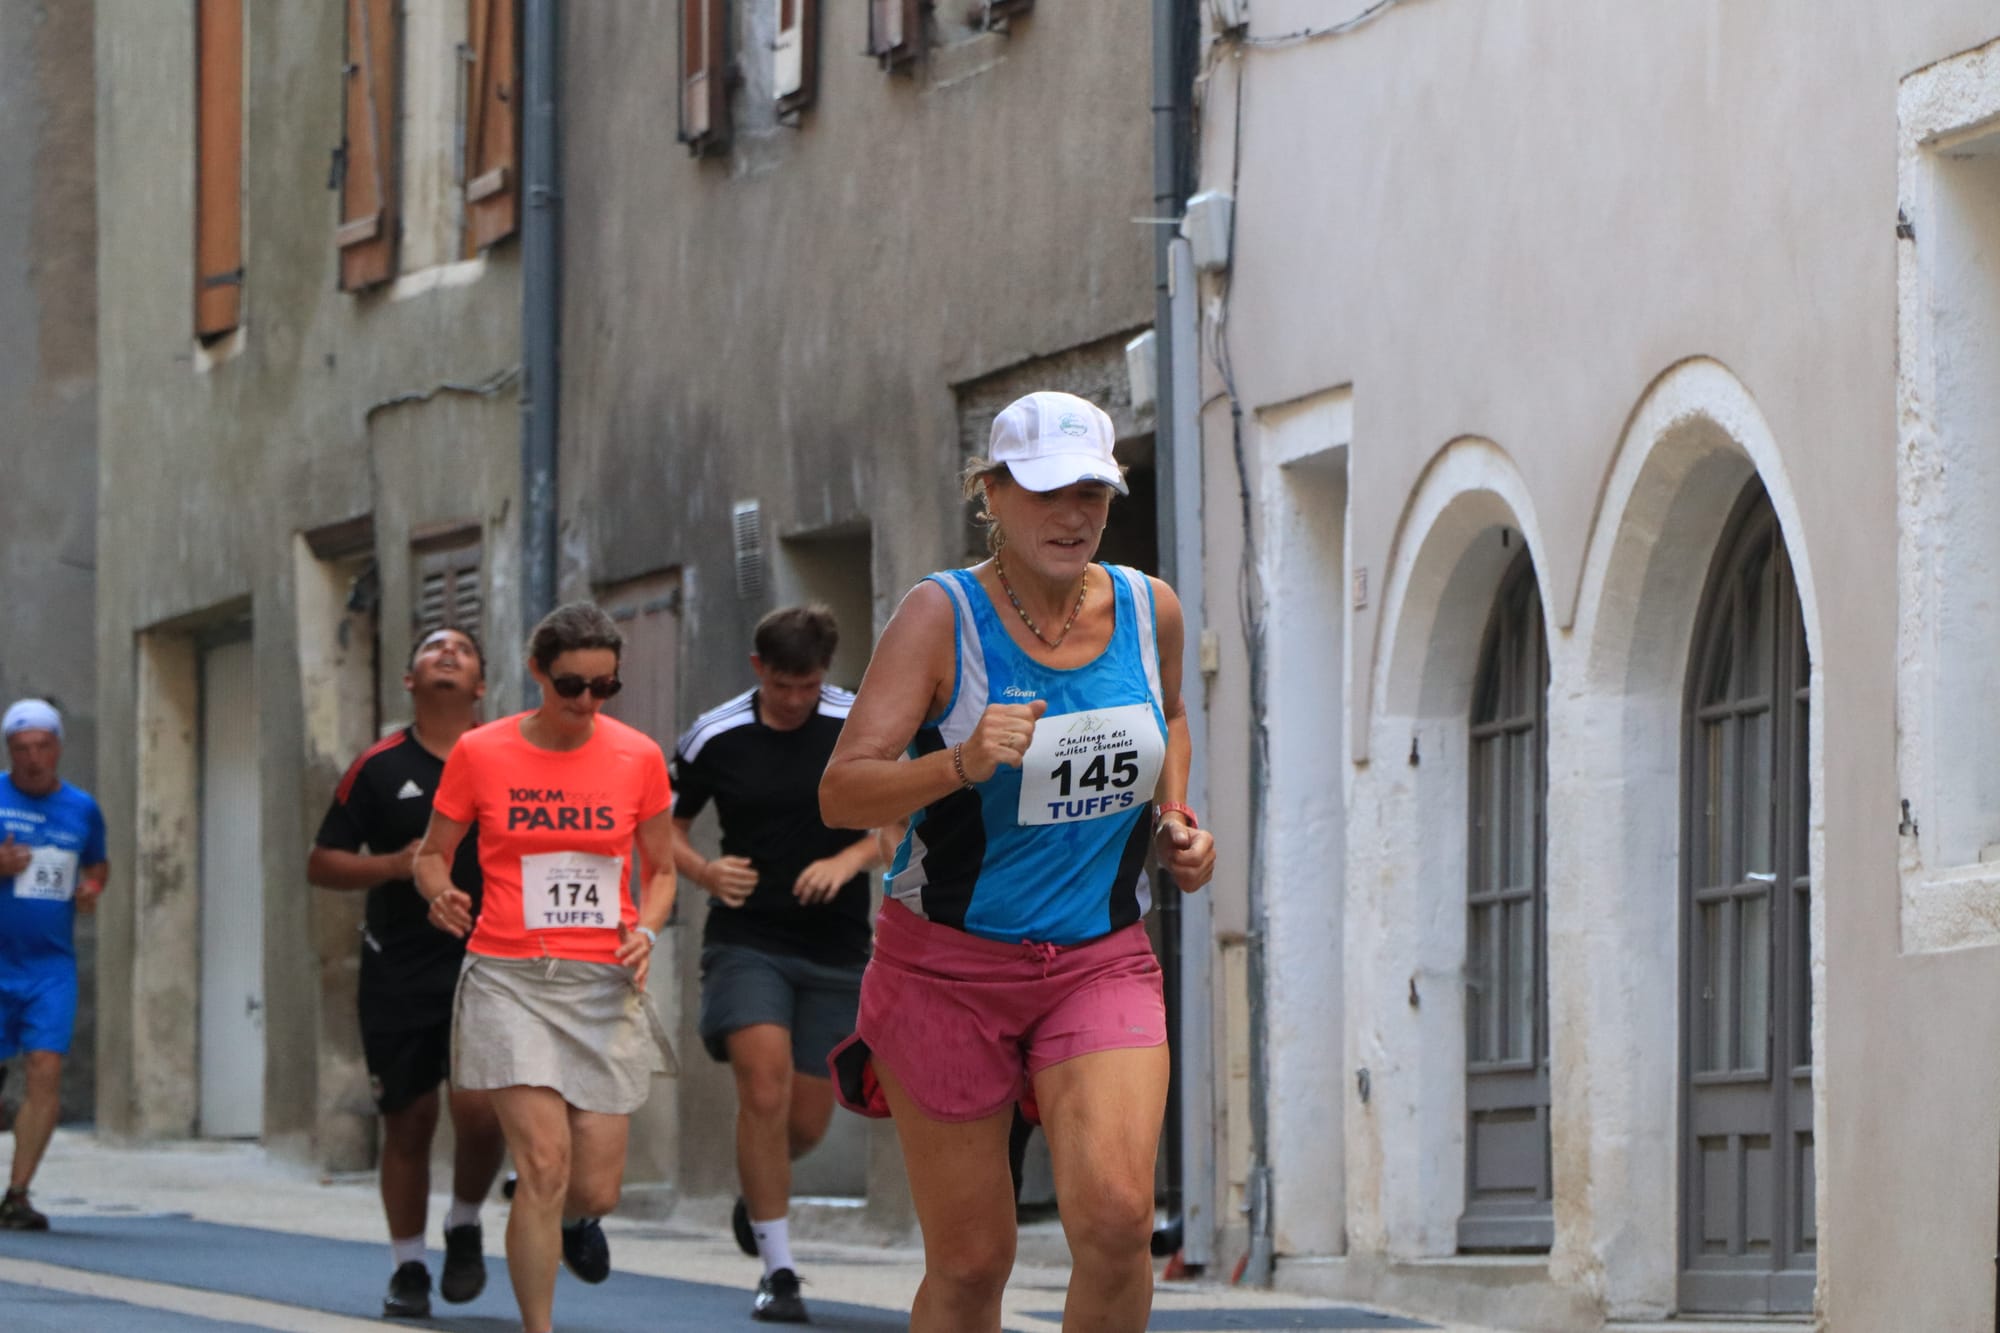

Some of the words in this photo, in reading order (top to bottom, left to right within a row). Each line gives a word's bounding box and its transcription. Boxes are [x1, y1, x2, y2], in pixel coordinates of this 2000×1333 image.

[1055, 746, 1087, 758] vallées
[1093, 739, 1133, 753] cévenoles
[1058, 733, 1106, 747] Challenge
[1112, 730, 1126, 739] des
[1051, 750, 1138, 796] 145
[508, 788, 566, 802] 10KM
[1048, 791, 1134, 819] TUFF'S
[507, 806, 617, 831] PARIS
[548, 883, 600, 907] 174
[544, 912, 604, 924] TUFF'S
